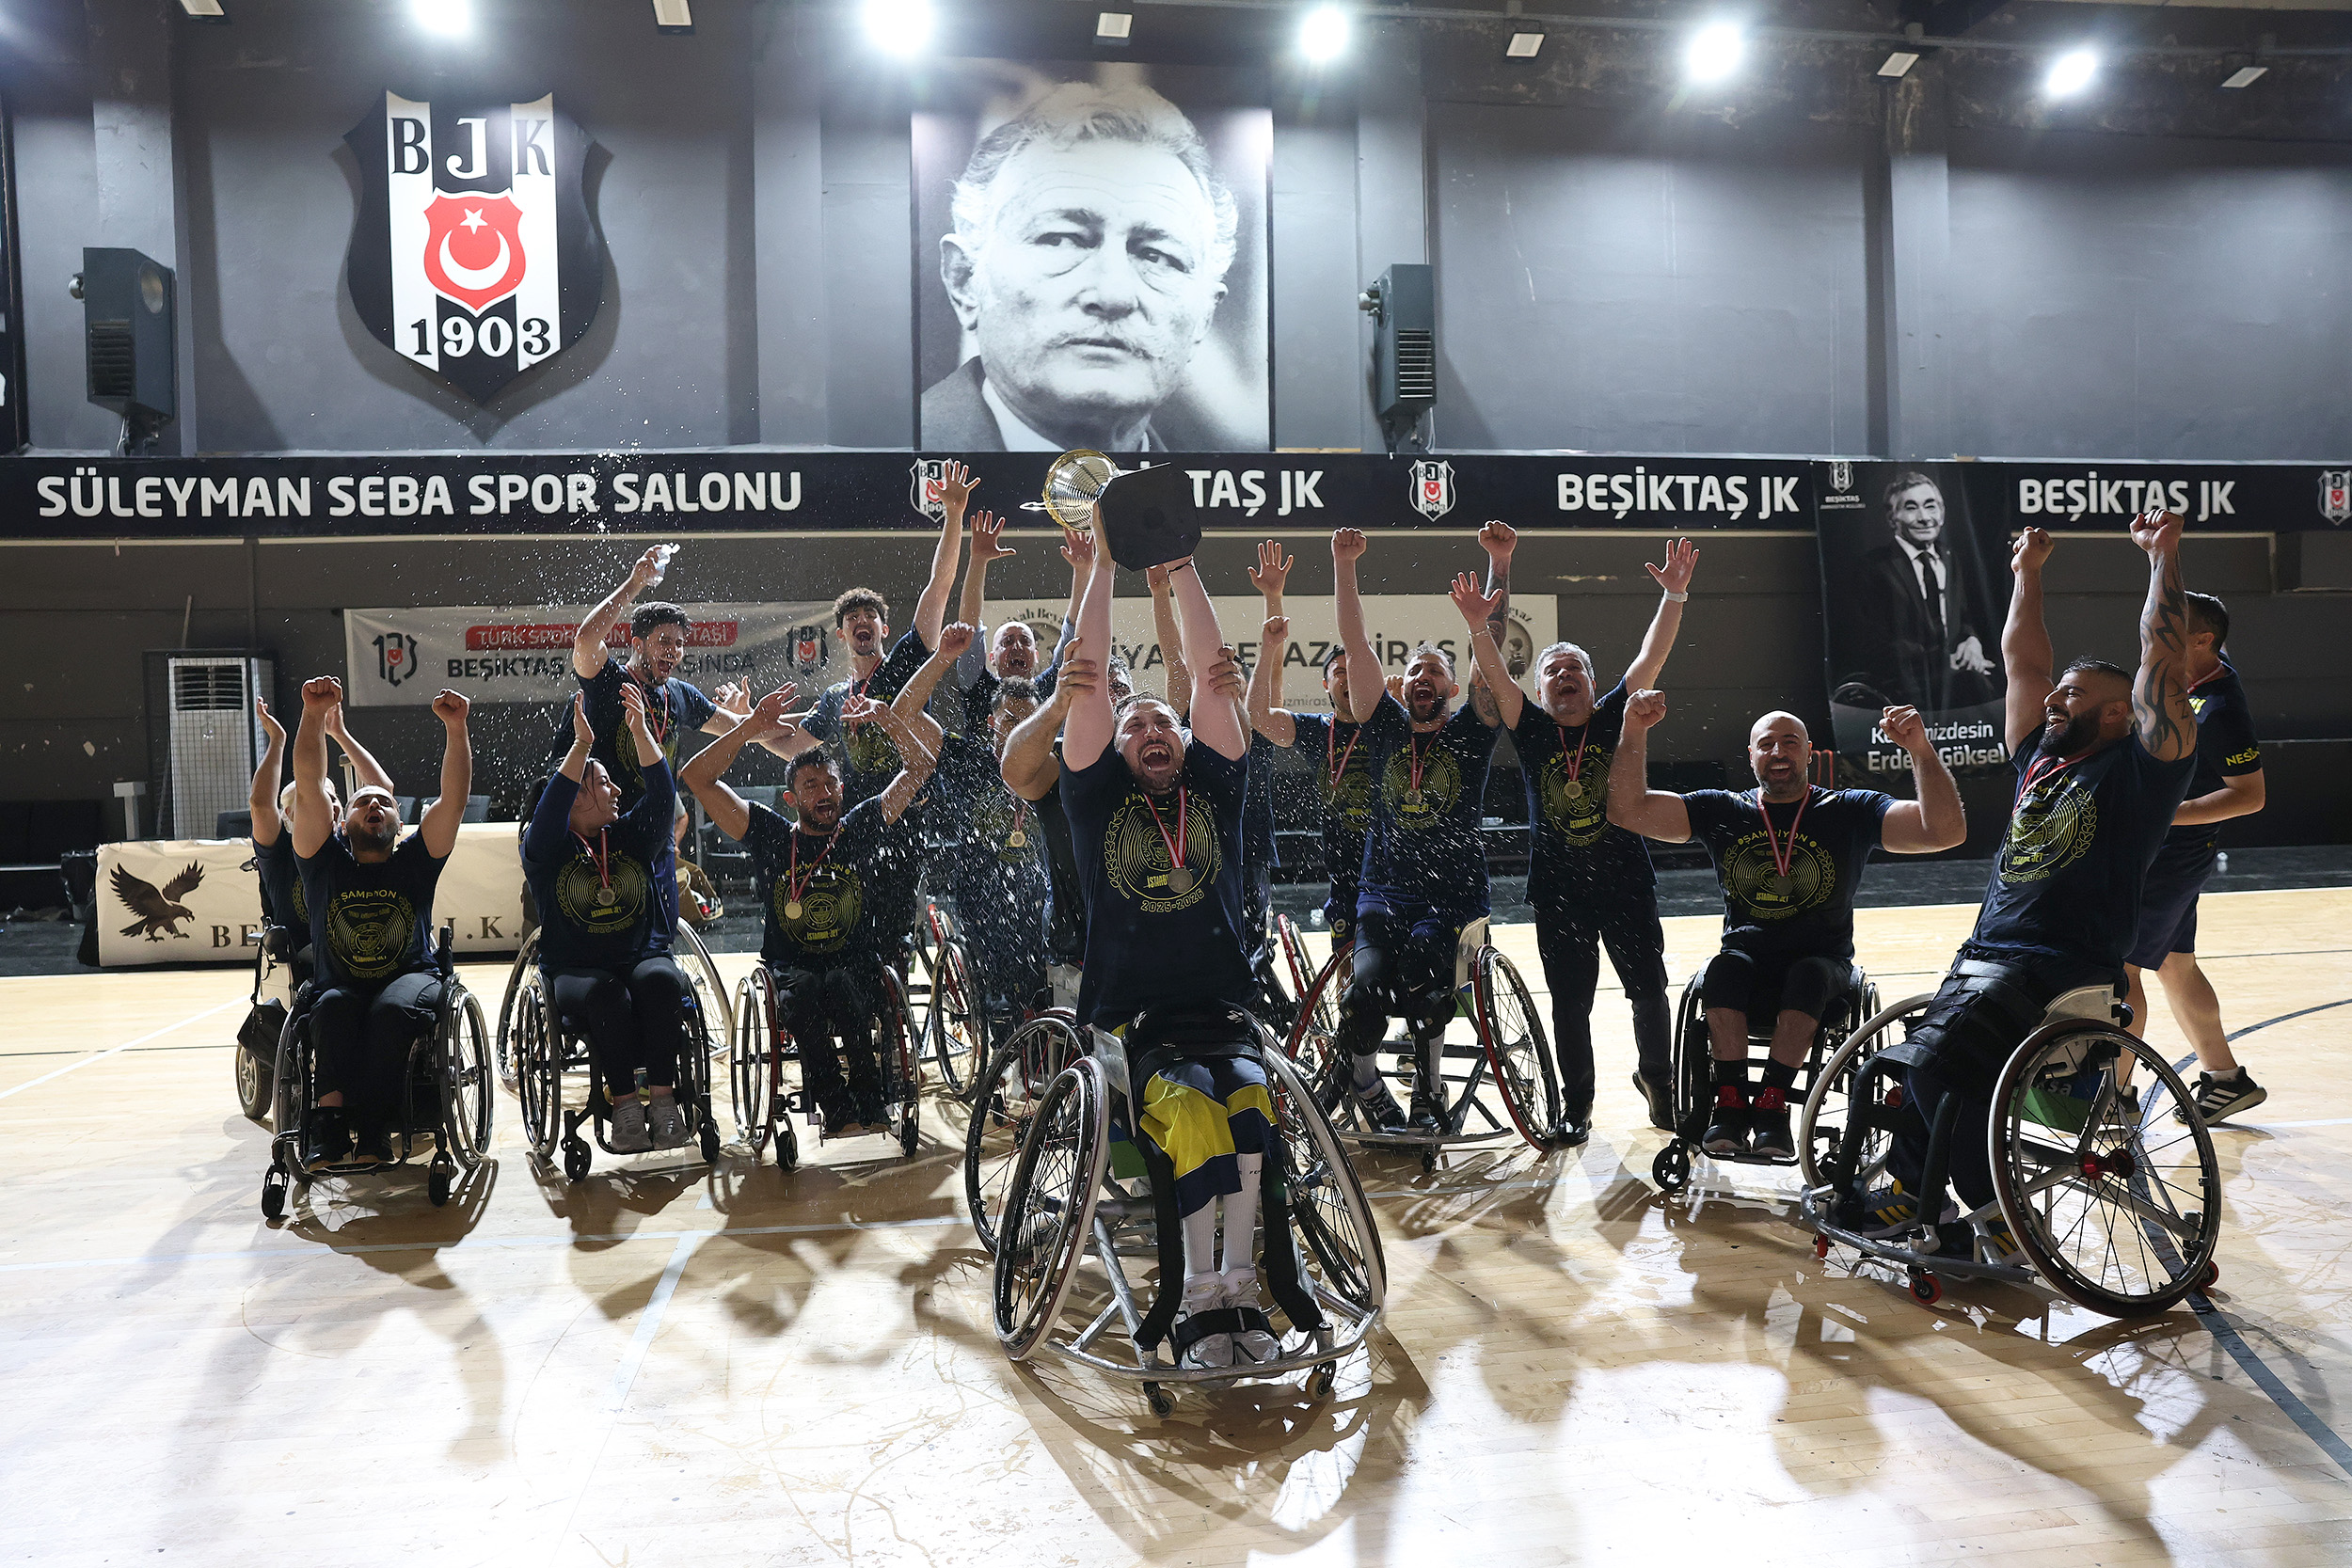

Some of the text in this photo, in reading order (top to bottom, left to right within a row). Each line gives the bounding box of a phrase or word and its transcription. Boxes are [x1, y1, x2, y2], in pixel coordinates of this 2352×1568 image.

[391, 117, 552, 180] BJK
[410, 315, 551, 357] 1903
[37, 467, 802, 517] SÜLEYMAN SEBA SPOR SALONU
[1278, 470, 1325, 516] JK
[1418, 466, 1446, 479] BJK
[1557, 467, 1800, 520] BEŞİKTAŞ JK
[1422, 503, 1446, 513] 1903
[2197, 480, 2236, 522] JK
[1867, 742, 2006, 771] Erde Göksel
[1140, 887, 1205, 913] 2025-2026
